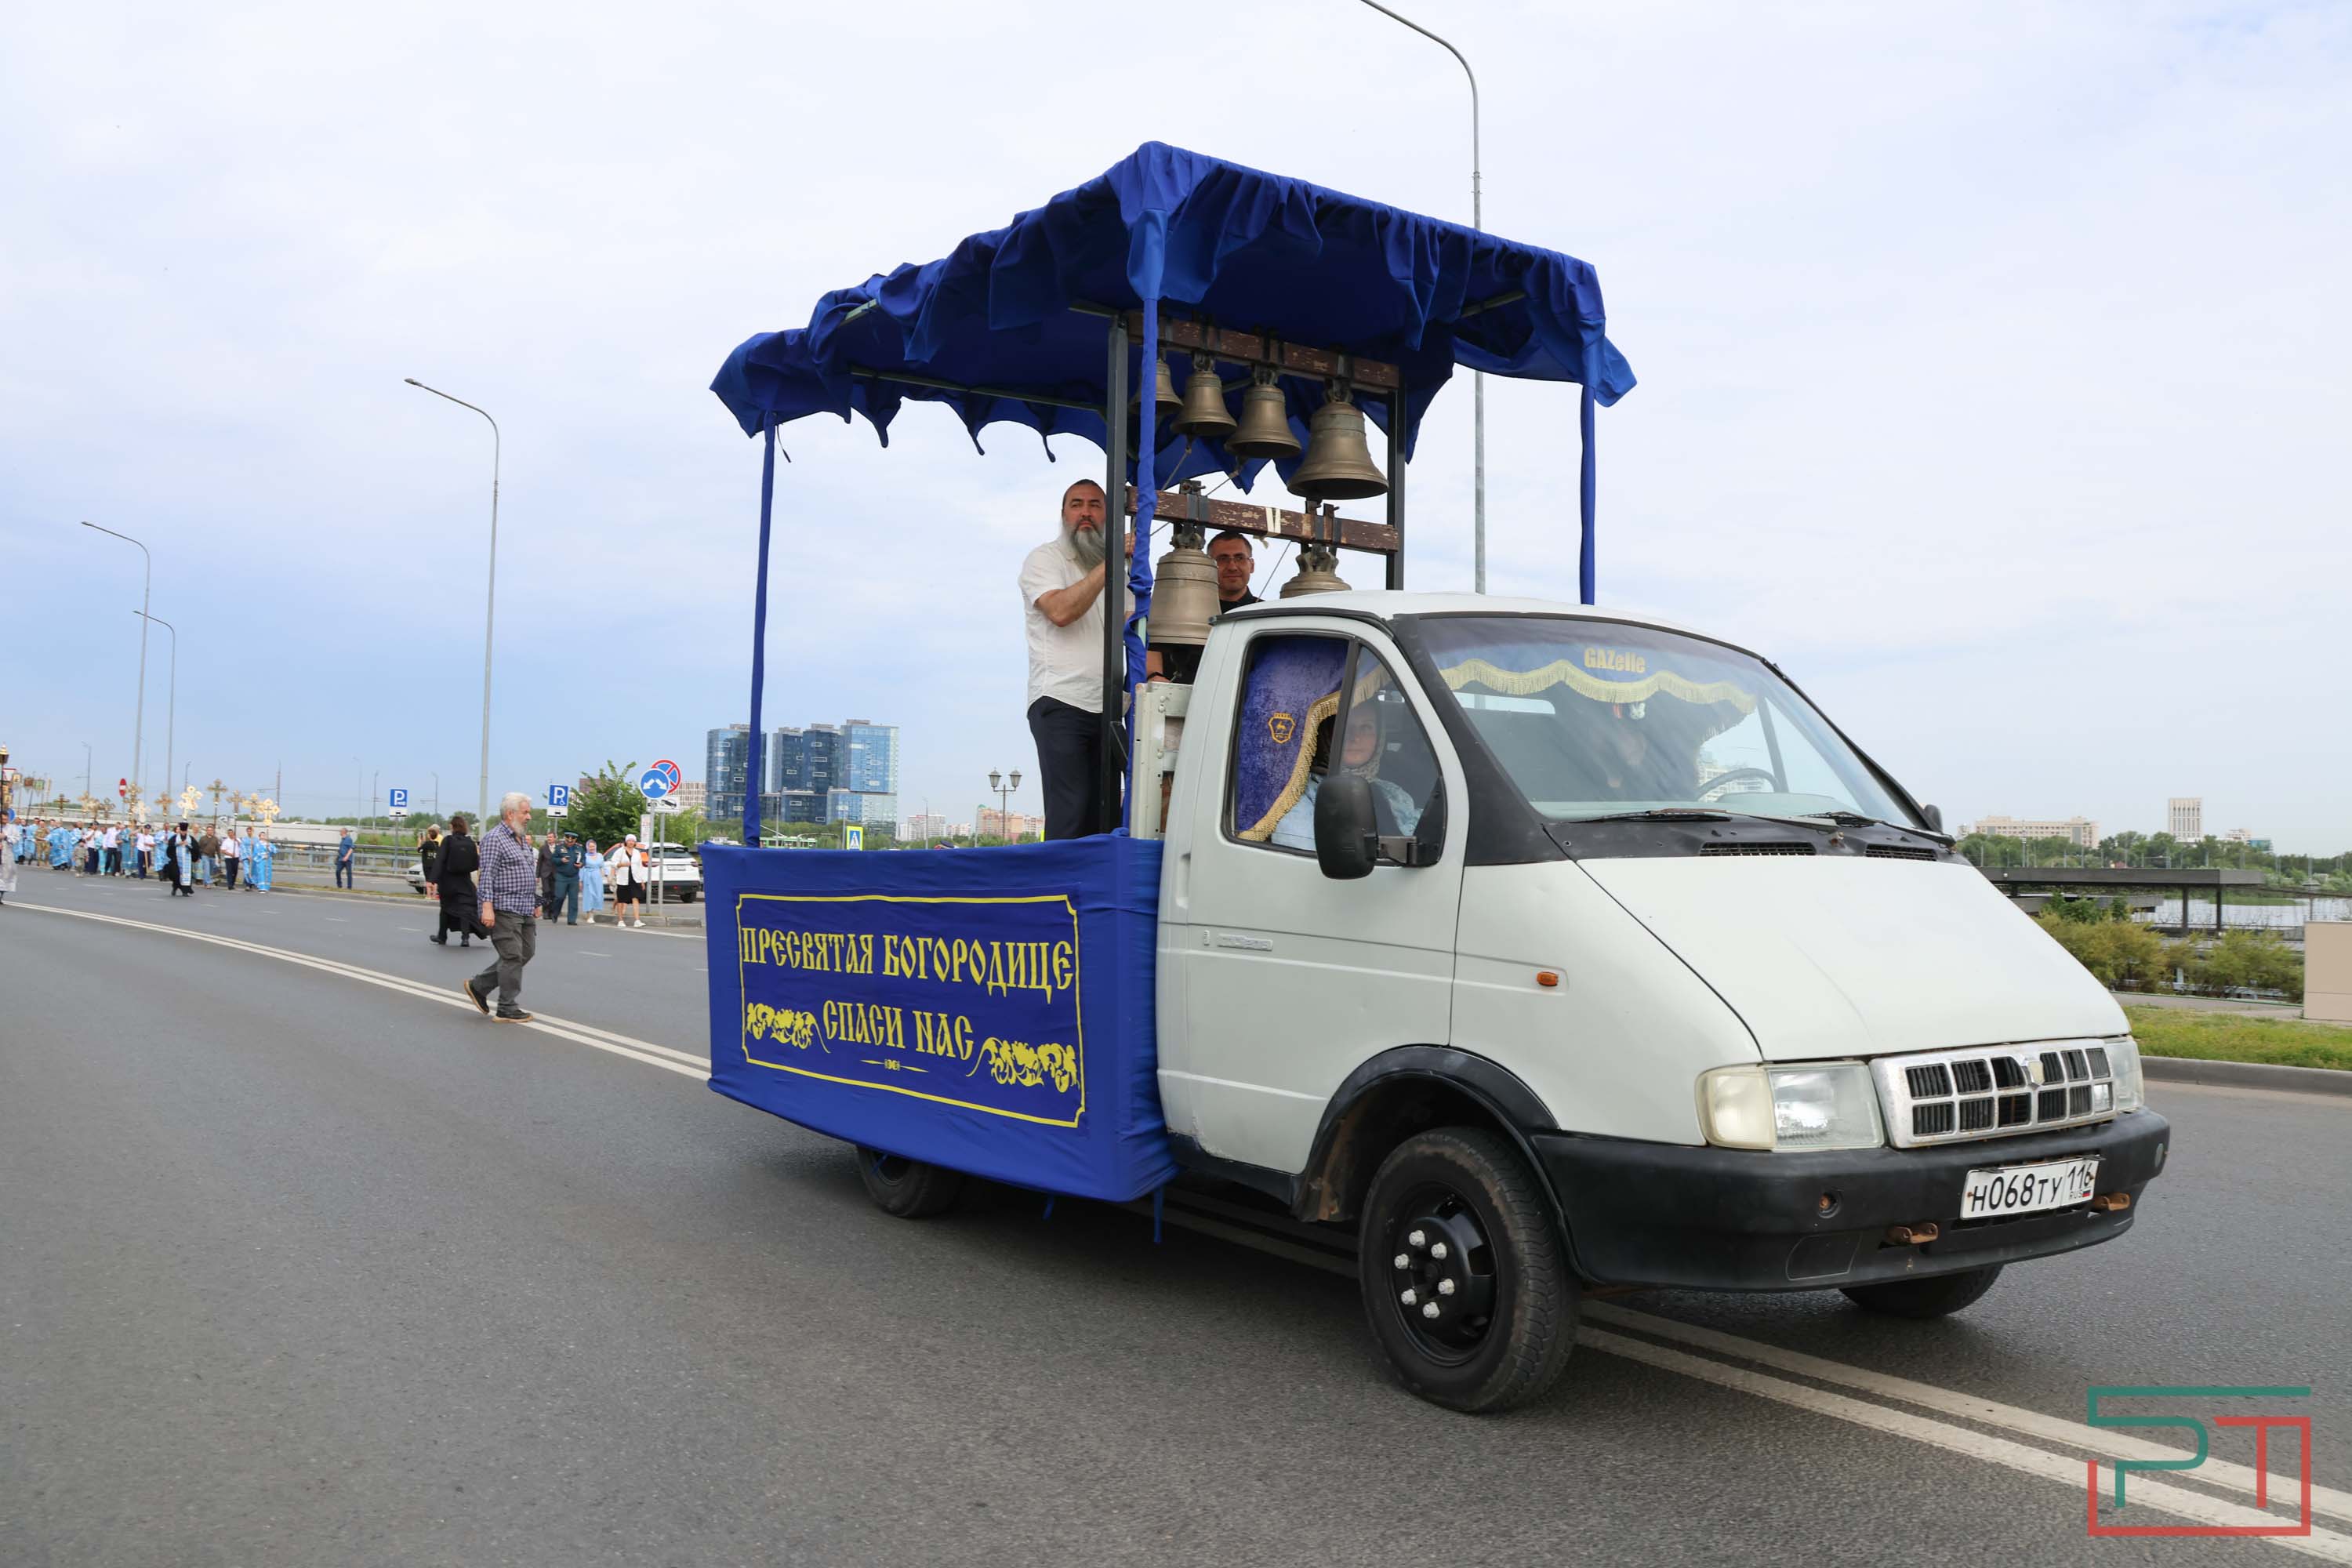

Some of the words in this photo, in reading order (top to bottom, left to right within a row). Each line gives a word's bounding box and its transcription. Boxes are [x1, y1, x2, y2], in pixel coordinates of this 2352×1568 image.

[1584, 648, 1645, 673] GAZelle
[394, 790, 405, 805] P
[554, 786, 565, 804] P
[742, 927, 874, 975] ПРЕСВЯТАЯ
[883, 935, 1073, 1004] БОГОРОДИЦЕ
[822, 1000, 906, 1049] СПАСИ
[2067, 1163, 2092, 1191] 116
